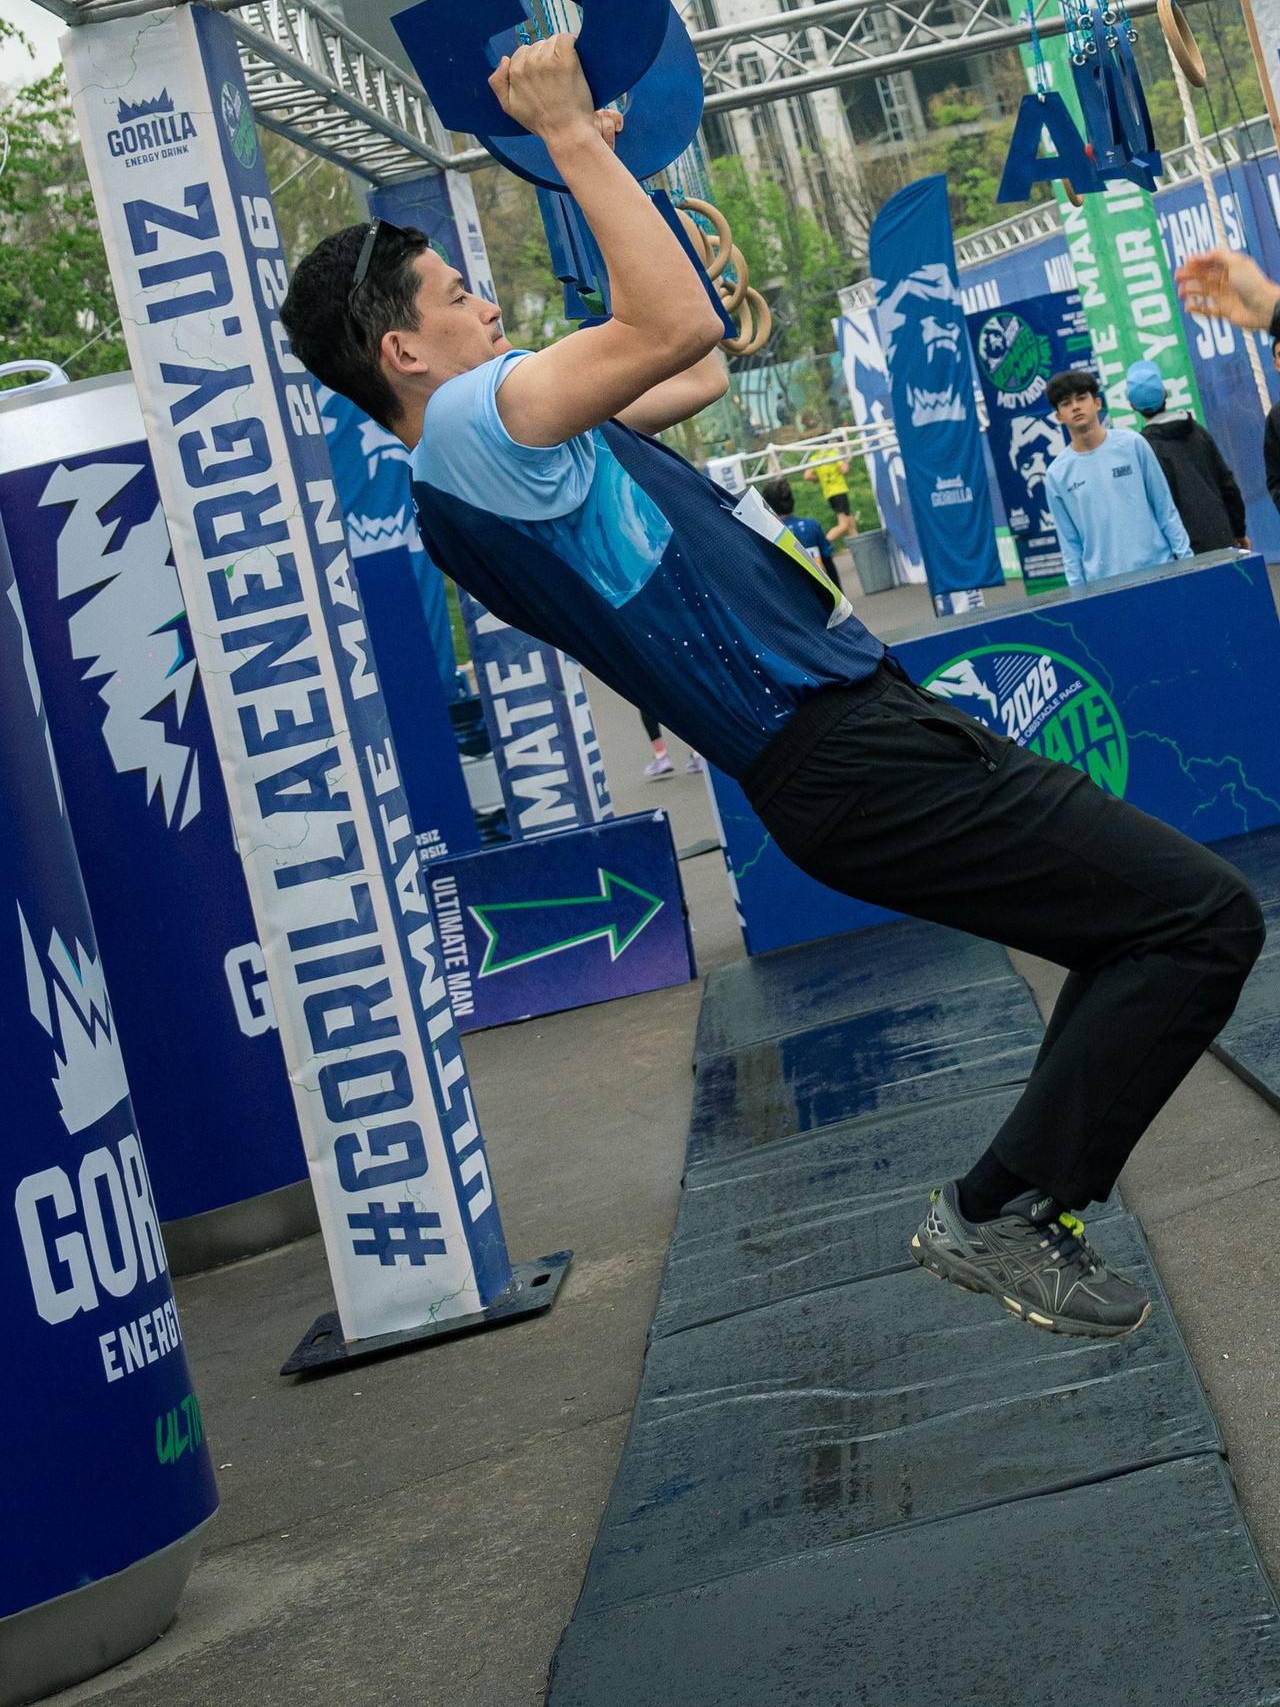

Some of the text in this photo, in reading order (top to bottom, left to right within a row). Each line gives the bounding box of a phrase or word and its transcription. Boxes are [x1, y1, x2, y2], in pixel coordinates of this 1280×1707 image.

[107, 112, 198, 157] GORILLA
[125, 143, 190, 169] ENERGY DRINK
[1059, 202, 1107, 309] MAN
[1115, 227, 1178, 361] YOUR
[123, 180, 449, 1268] #GORILLAENERGY.UZ
[240, 195, 489, 1223] ULTIMATE MAN 2026
[1001, 654, 1058, 742] 2026
[1024, 679, 1083, 740] OBSTACLE RACE
[431, 875, 475, 1018] ULTIMATE MAN
